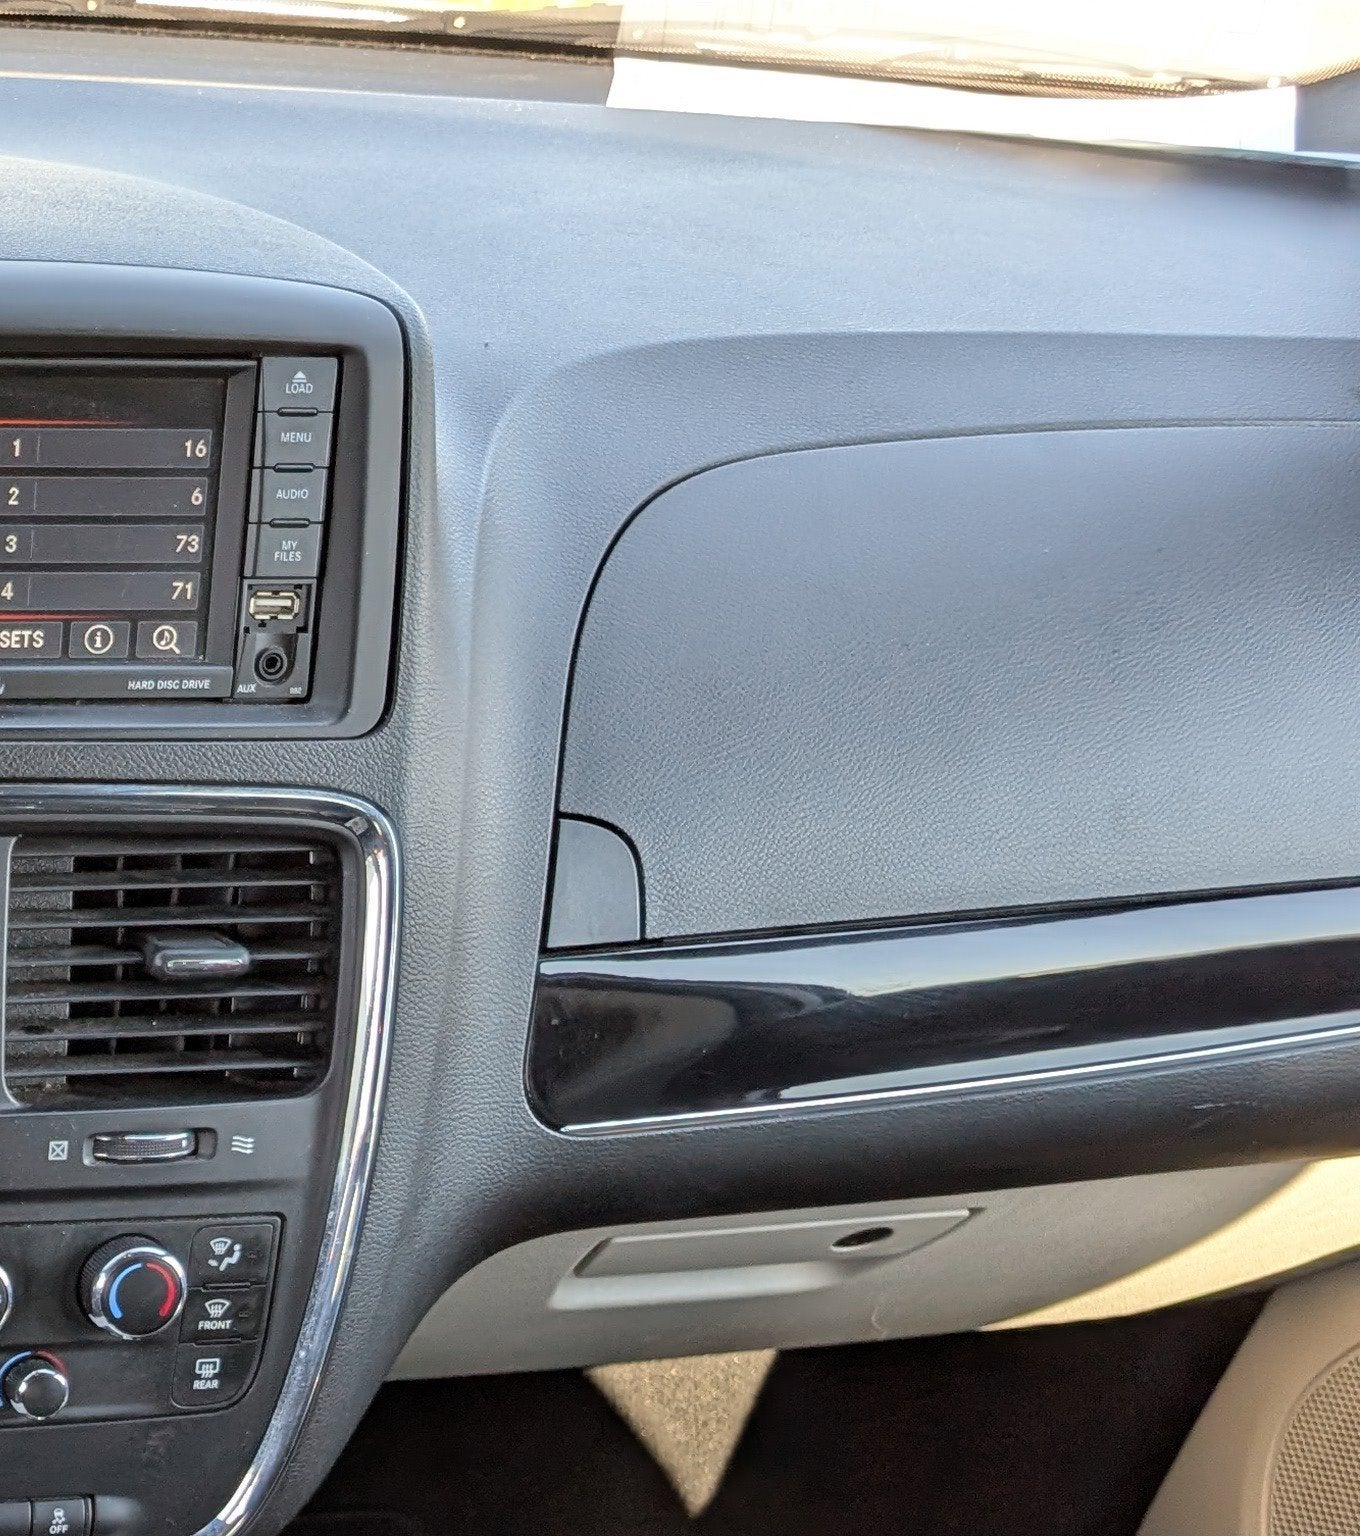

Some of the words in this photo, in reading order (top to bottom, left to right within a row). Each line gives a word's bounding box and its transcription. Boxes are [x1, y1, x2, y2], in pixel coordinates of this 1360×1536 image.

[285, 383, 313, 394] LOAD
[280, 432, 312, 443] MENU
[12, 438, 21, 458] 1
[184, 439, 207, 458] 16
[7, 487, 20, 506] 2
[191, 487, 203, 505] 6
[276, 488, 309, 499] AUDIO
[5, 535, 18, 553] 3
[175, 535, 200, 553] 73
[281, 540, 298, 550] MY
[274, 551, 302, 561] FILES
[0, 581, 14, 600] 4
[171, 581, 193, 600] 71
[127, 680, 155, 690] HARD
[157, 680, 180, 690] DISC
[182, 679, 210, 689] DRIVE
[237, 683, 257, 694] AUX
[198, 1320, 232, 1331] FRONT
[193, 1379, 219, 1390] REAR
[49, 1524, 68, 1535] OFF
